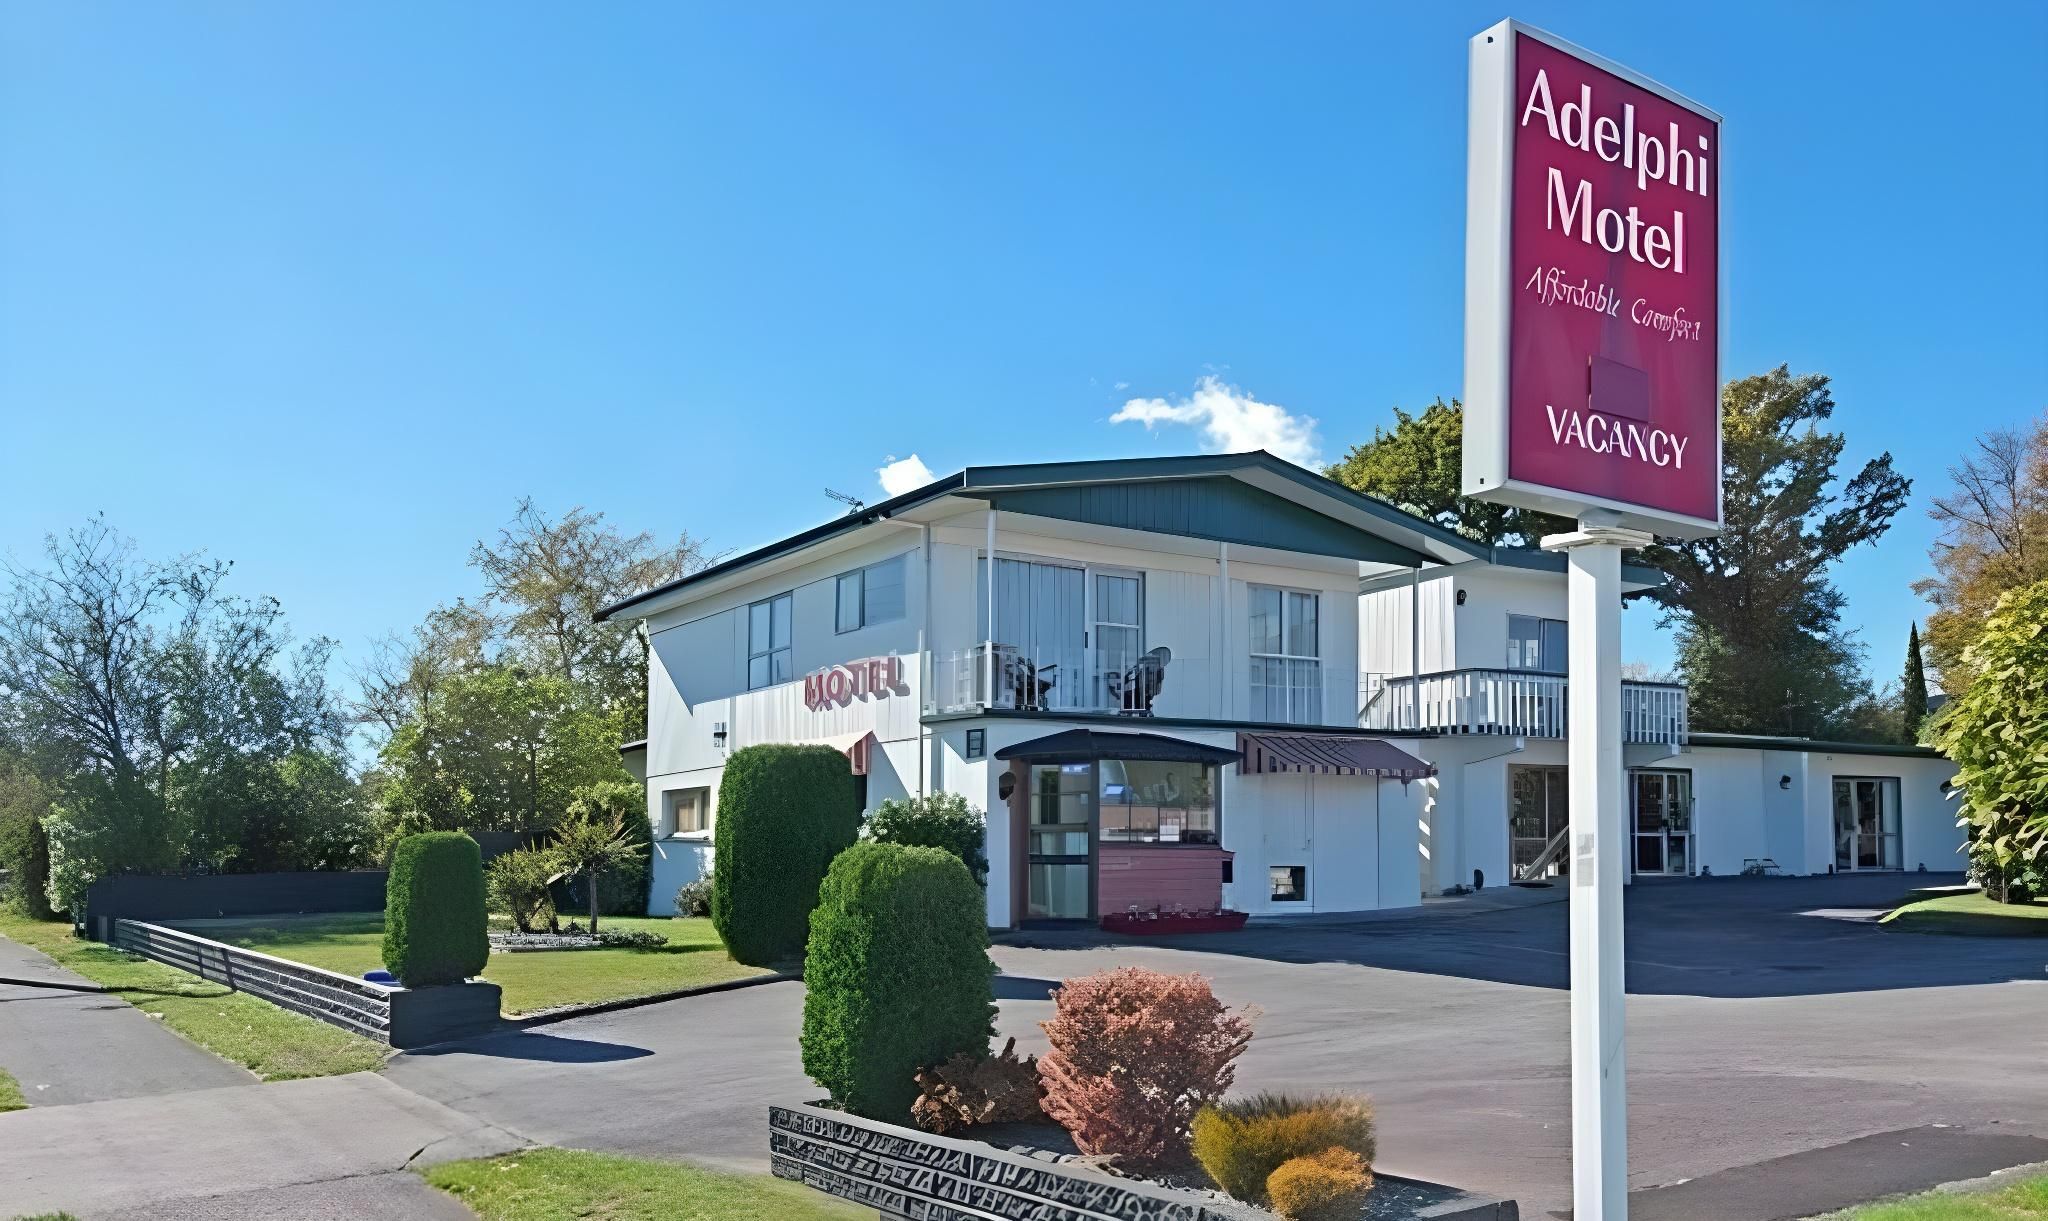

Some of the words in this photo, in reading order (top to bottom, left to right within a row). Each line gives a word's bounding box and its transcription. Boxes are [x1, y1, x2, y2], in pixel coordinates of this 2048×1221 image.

[1520, 67, 1708, 198] Adelphi
[1546, 166, 1685, 275] Motel
[1546, 404, 1689, 470] VACANCY
[804, 655, 909, 711] MOTEL
